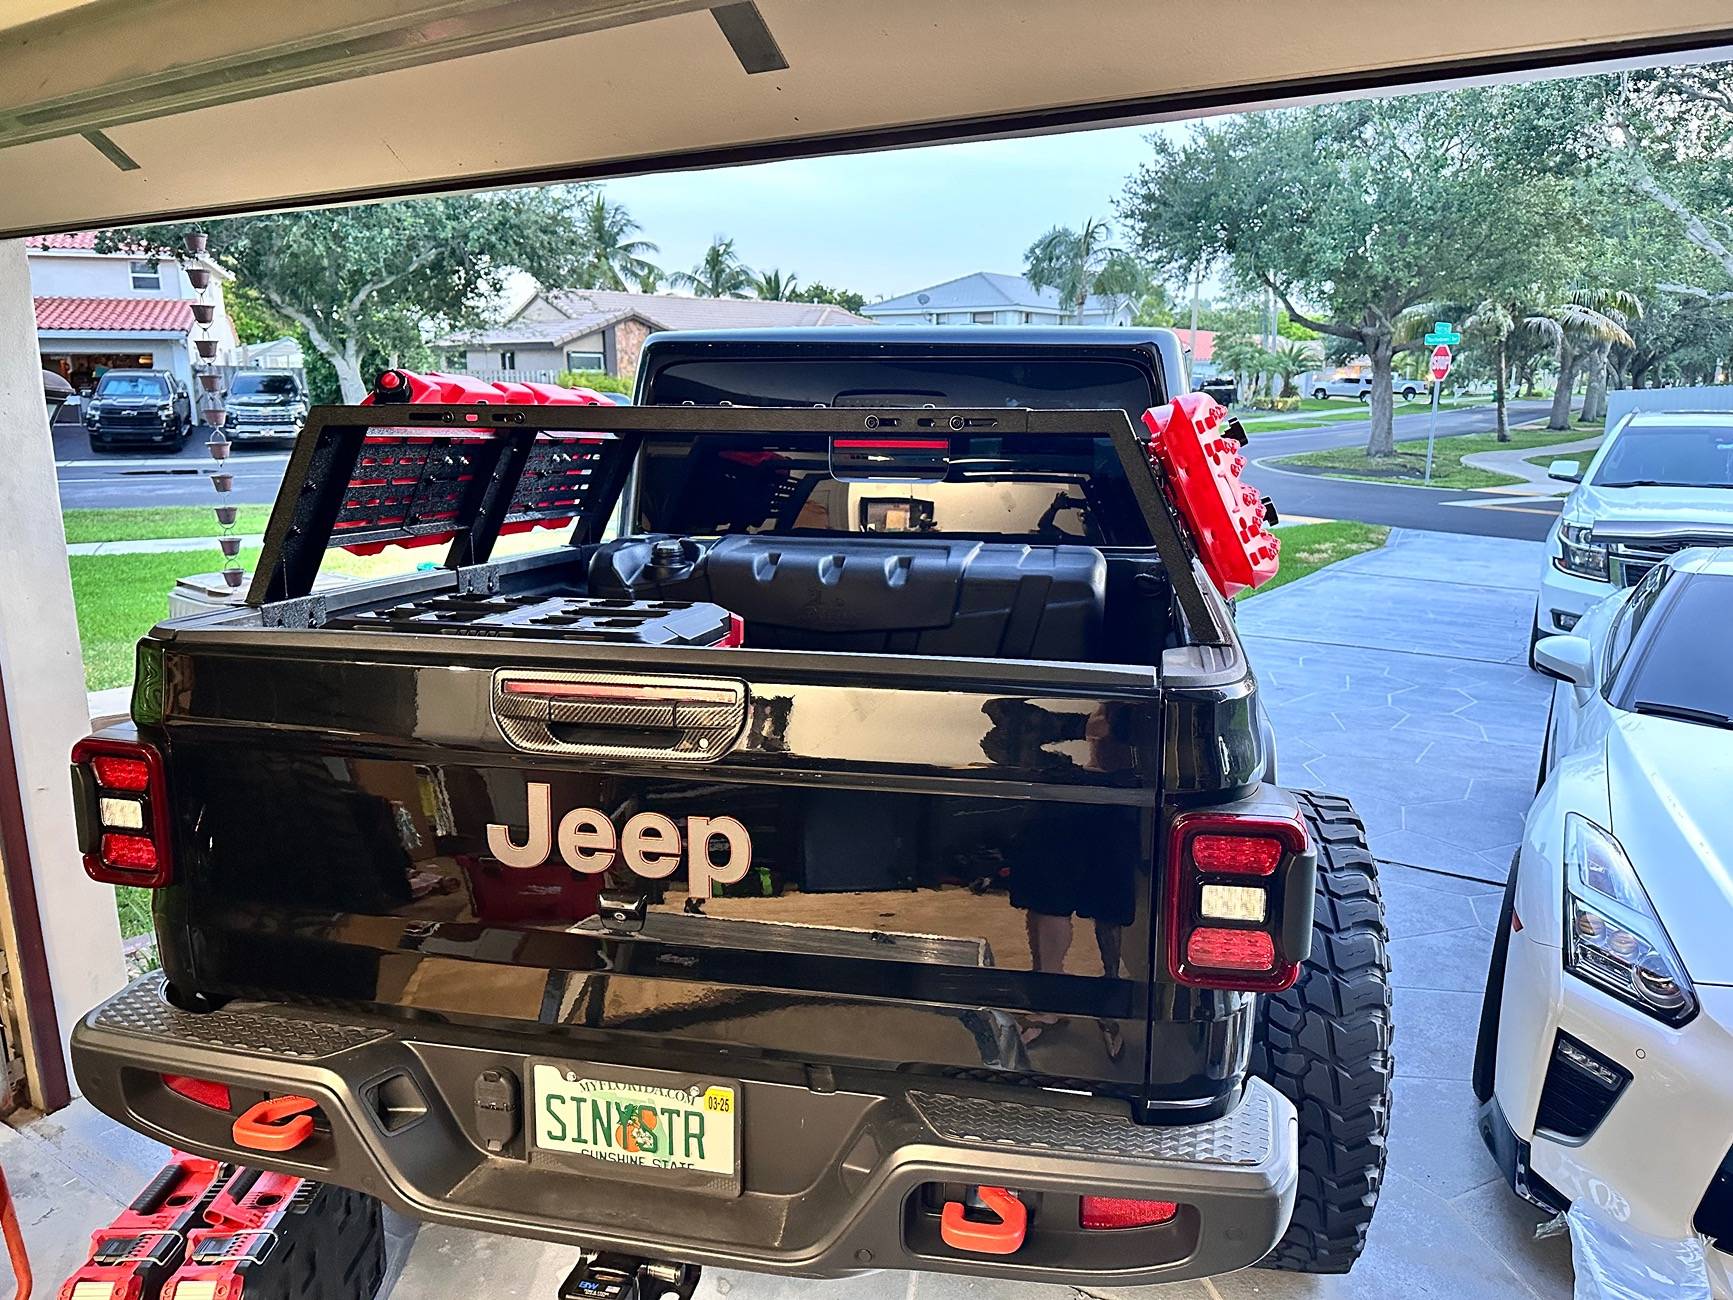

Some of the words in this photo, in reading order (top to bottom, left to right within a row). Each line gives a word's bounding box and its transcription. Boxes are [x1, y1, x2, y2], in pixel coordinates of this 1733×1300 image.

[1432, 355, 1450, 370] STOP
[487, 782, 752, 899] Jeep
[579, 1080, 695, 1106] MYFLORIDA.COM
[708, 1096, 730, 1112] 03-25
[545, 1093, 705, 1159] SINYSTR
